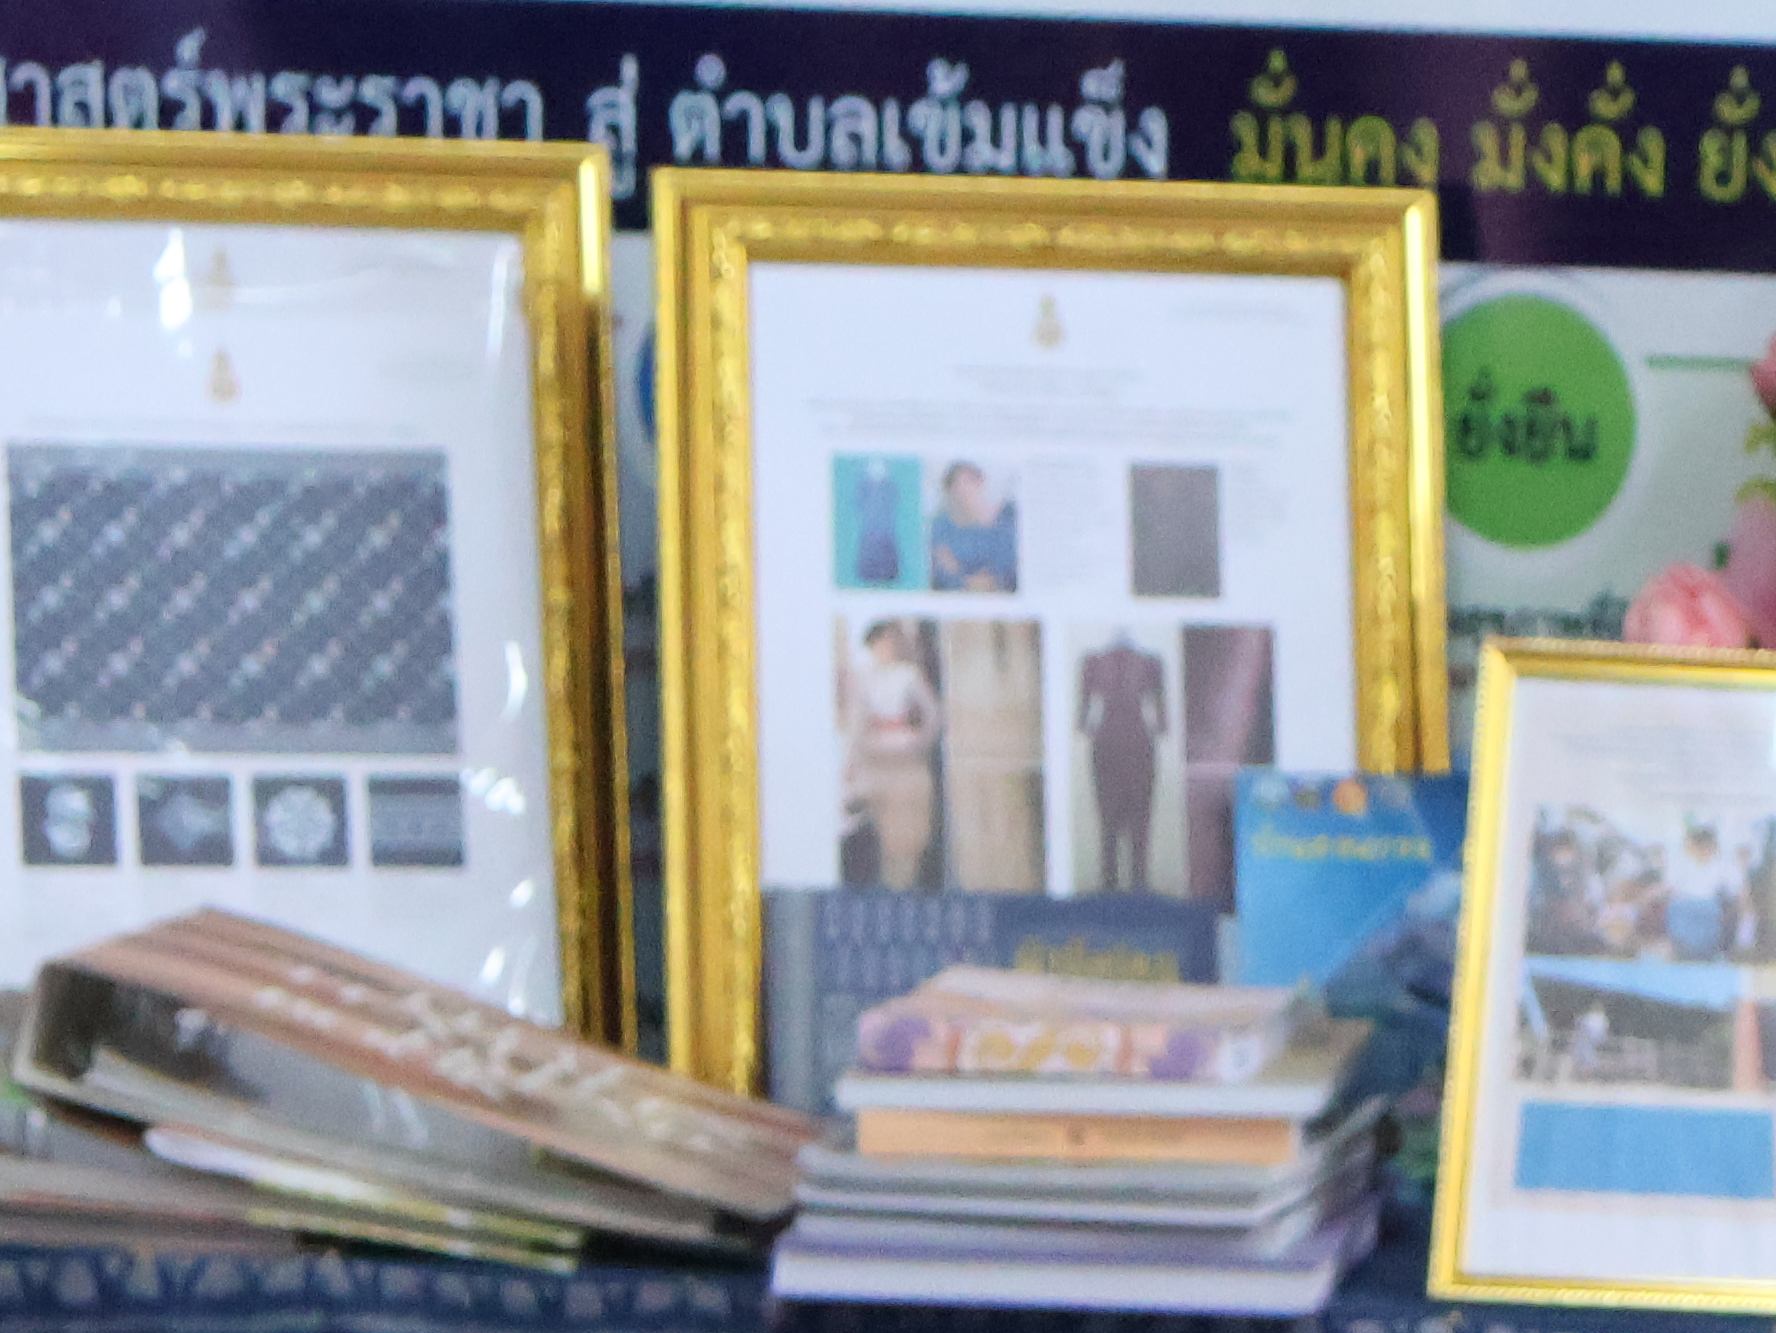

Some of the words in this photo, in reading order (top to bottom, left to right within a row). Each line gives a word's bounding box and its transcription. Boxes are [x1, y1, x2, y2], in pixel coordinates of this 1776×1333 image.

[0, 26, 545, 142] าสตร์พระราชา
[668, 53, 1169, 180] ตำบลเข้มแข็ง
[1230, 48, 1440, 186] มั่นคง
[1471, 58, 1667, 198] มั่งคั่ง
